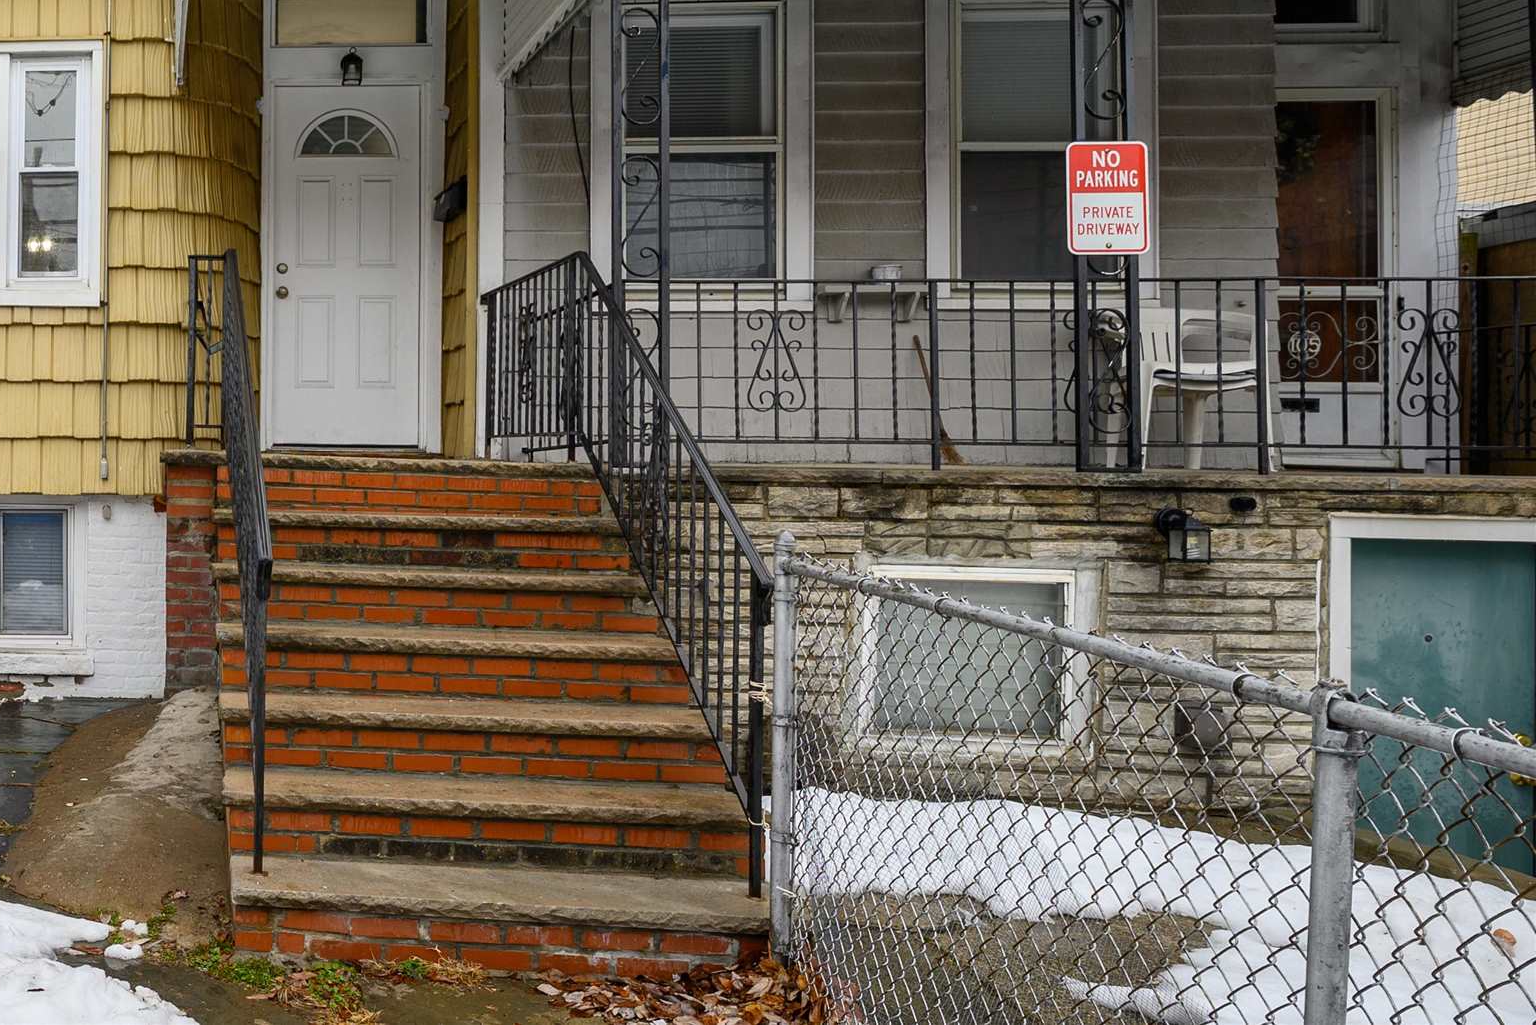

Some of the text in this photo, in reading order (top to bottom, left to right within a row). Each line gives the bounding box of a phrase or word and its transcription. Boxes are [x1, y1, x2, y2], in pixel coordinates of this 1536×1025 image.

[1092, 150, 1120, 167] NO
[1076, 170, 1139, 187] PARKING
[1082, 206, 1134, 219] PRIVATE
[1077, 222, 1140, 236] DRIVEWAY
[1290, 337, 1319, 352] 105
